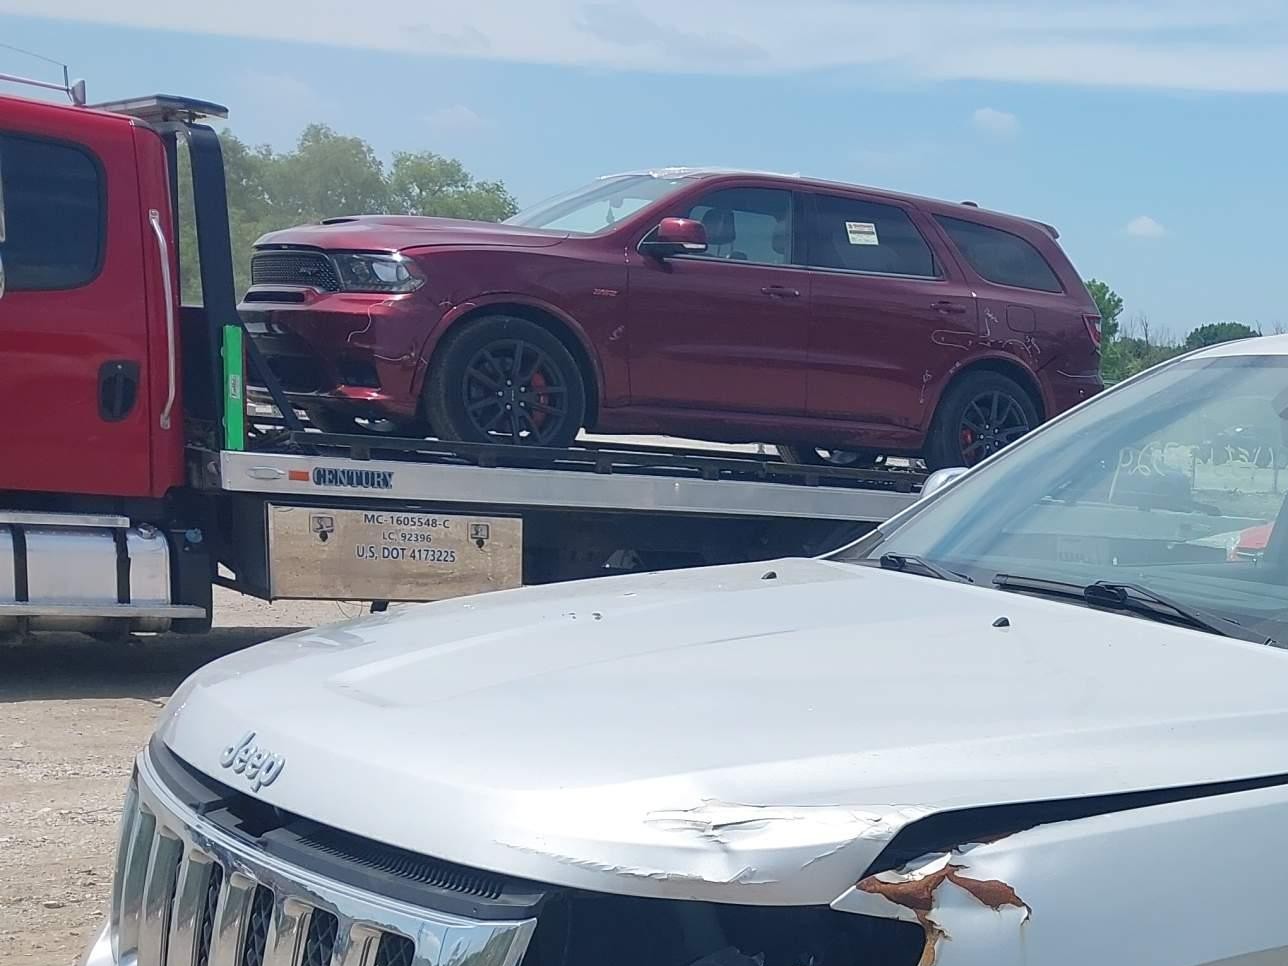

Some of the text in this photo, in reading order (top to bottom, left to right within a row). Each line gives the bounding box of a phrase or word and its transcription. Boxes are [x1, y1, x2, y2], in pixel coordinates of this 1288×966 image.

[312, 466, 394, 489] CENTURY
[363, 513, 450, 529] MC-1605548-C
[400, 532, 432, 543] 92396
[382, 546, 407, 560] DOT
[409, 548, 456, 563] 4173225
[220, 730, 287, 794] Jeep
